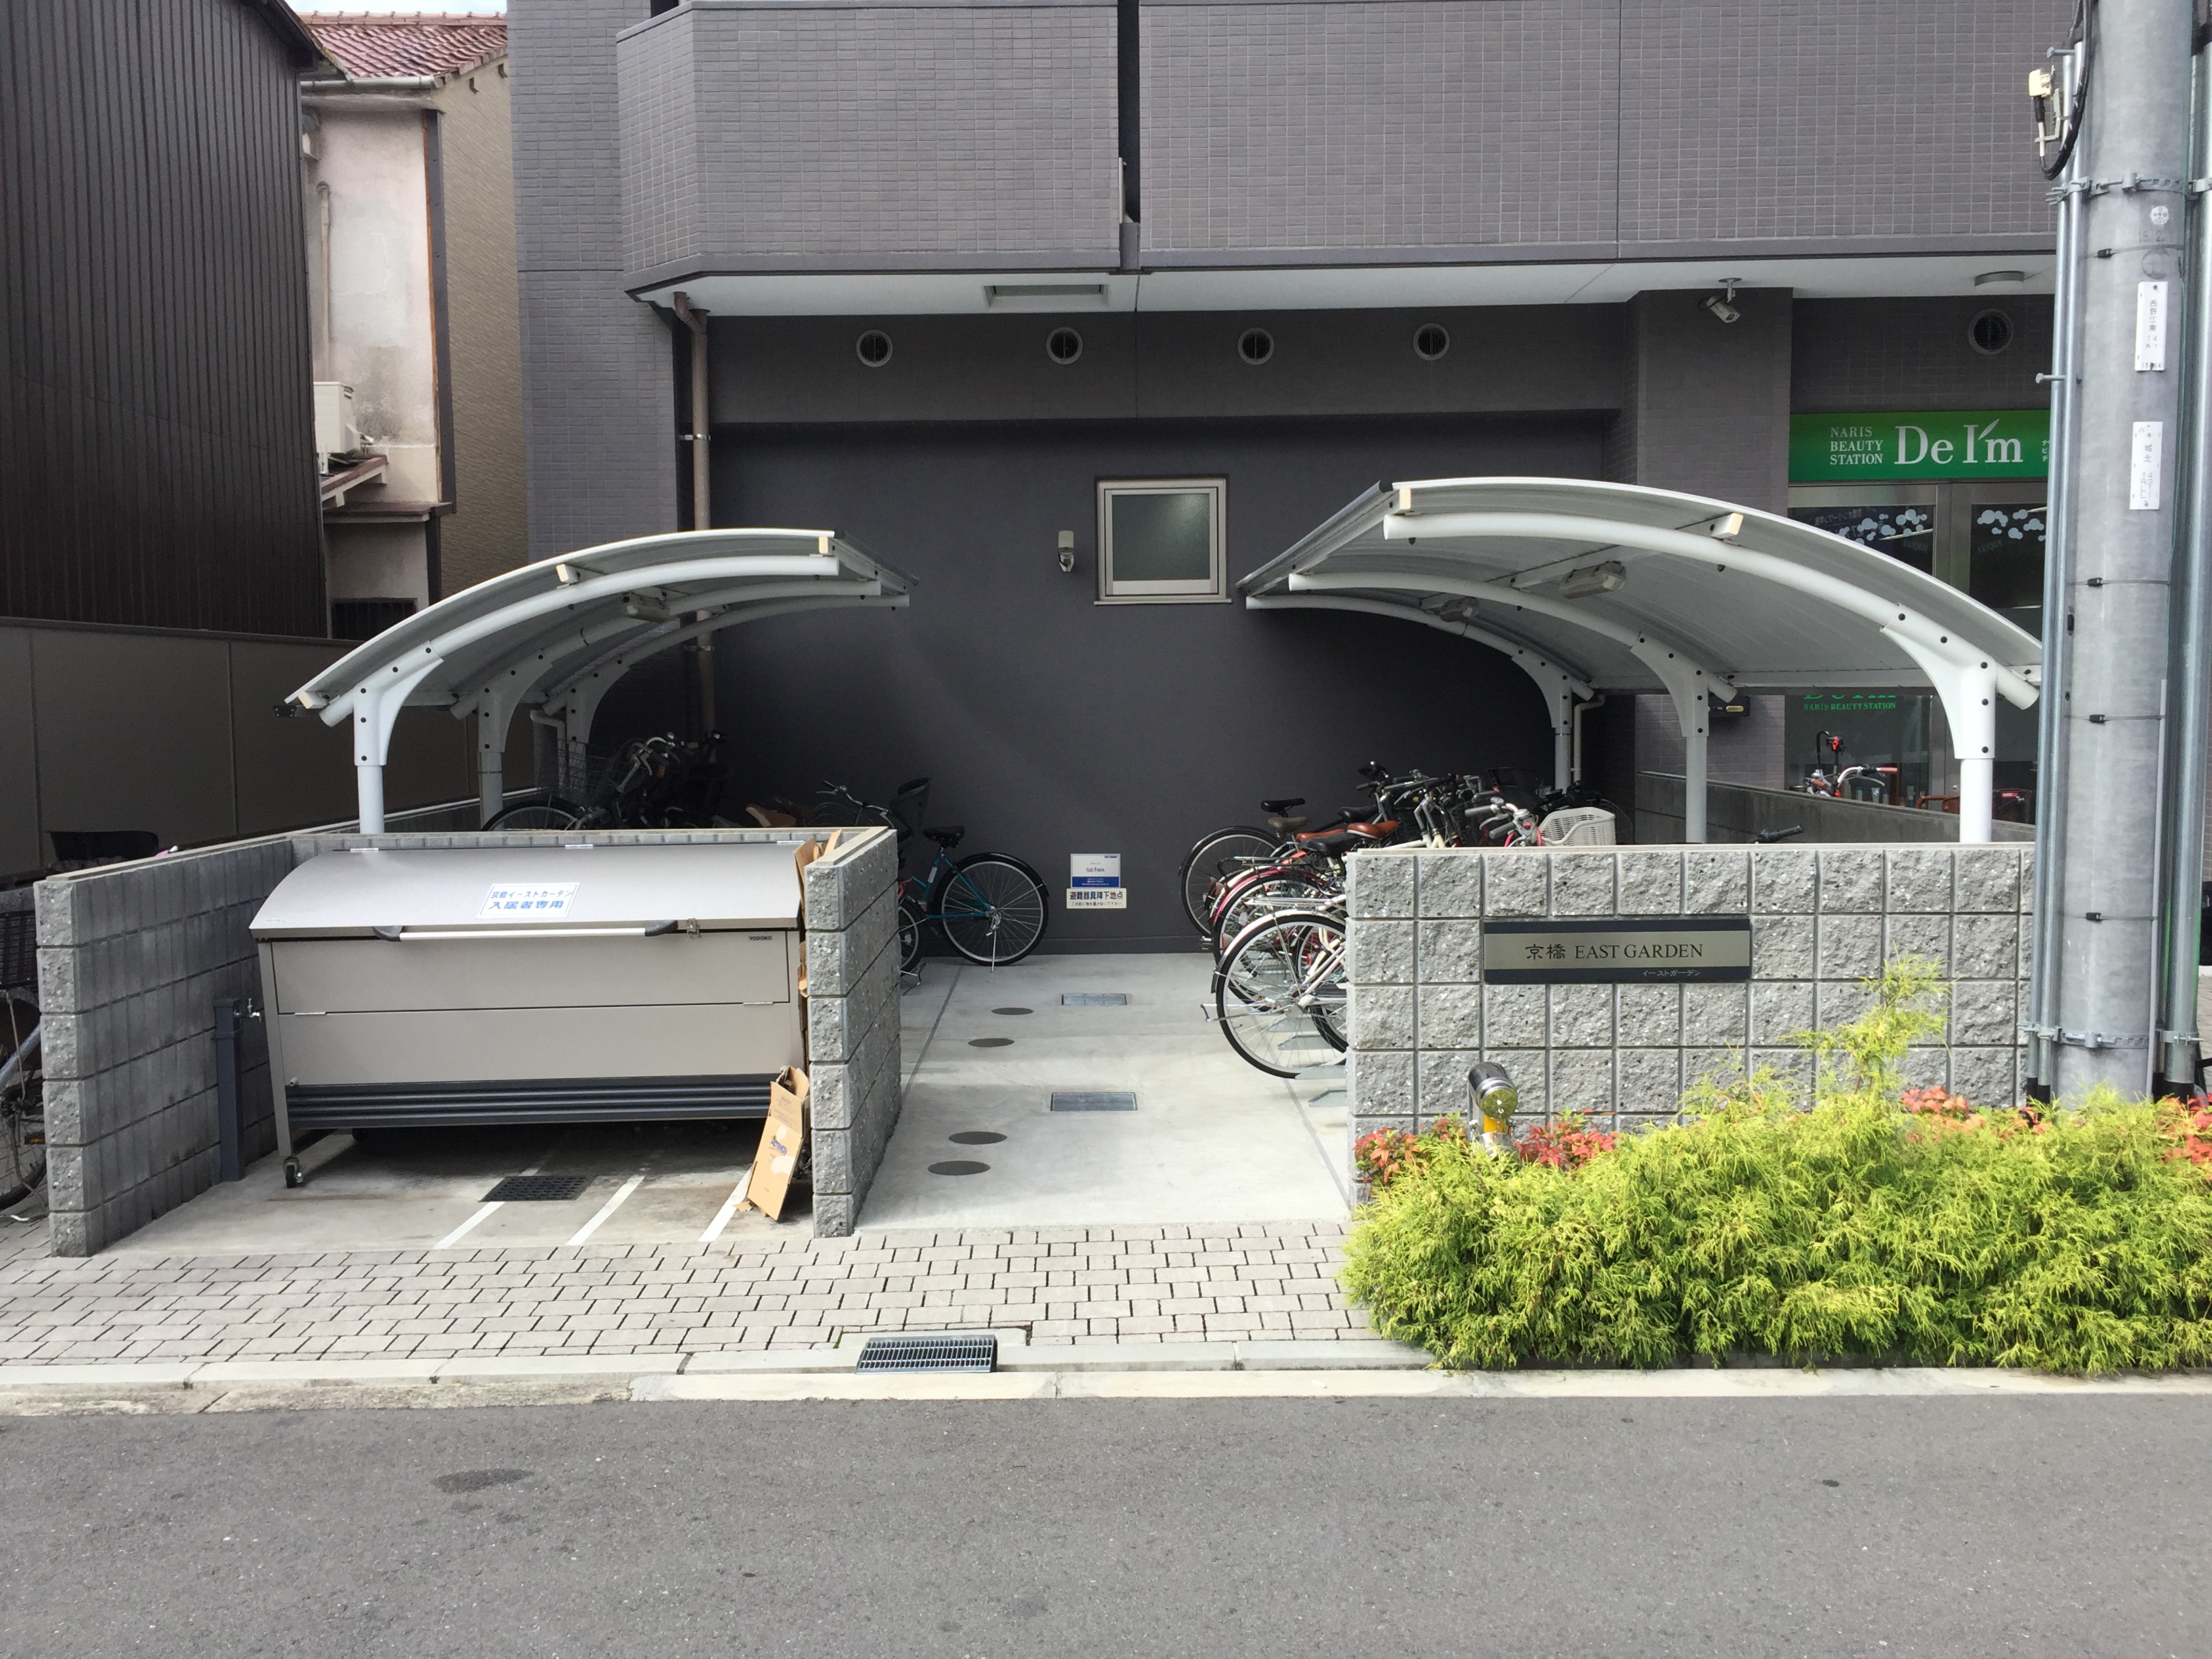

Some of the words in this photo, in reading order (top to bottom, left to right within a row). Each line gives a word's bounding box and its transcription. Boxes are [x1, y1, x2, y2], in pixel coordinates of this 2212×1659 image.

[1830, 426, 1872, 438] NARIS
[1830, 440, 1883, 451] BEAUTY
[1893, 425, 1954, 465] De
[1830, 453, 1883, 466] STATION
[1864, 702, 1896, 710] STATION
[488, 901, 565, 910] 入居者専用
[1525, 943, 1567, 960] 京橋
[1574, 945, 1620, 959] EAST
[1624, 943, 1704, 958] GARDEN
